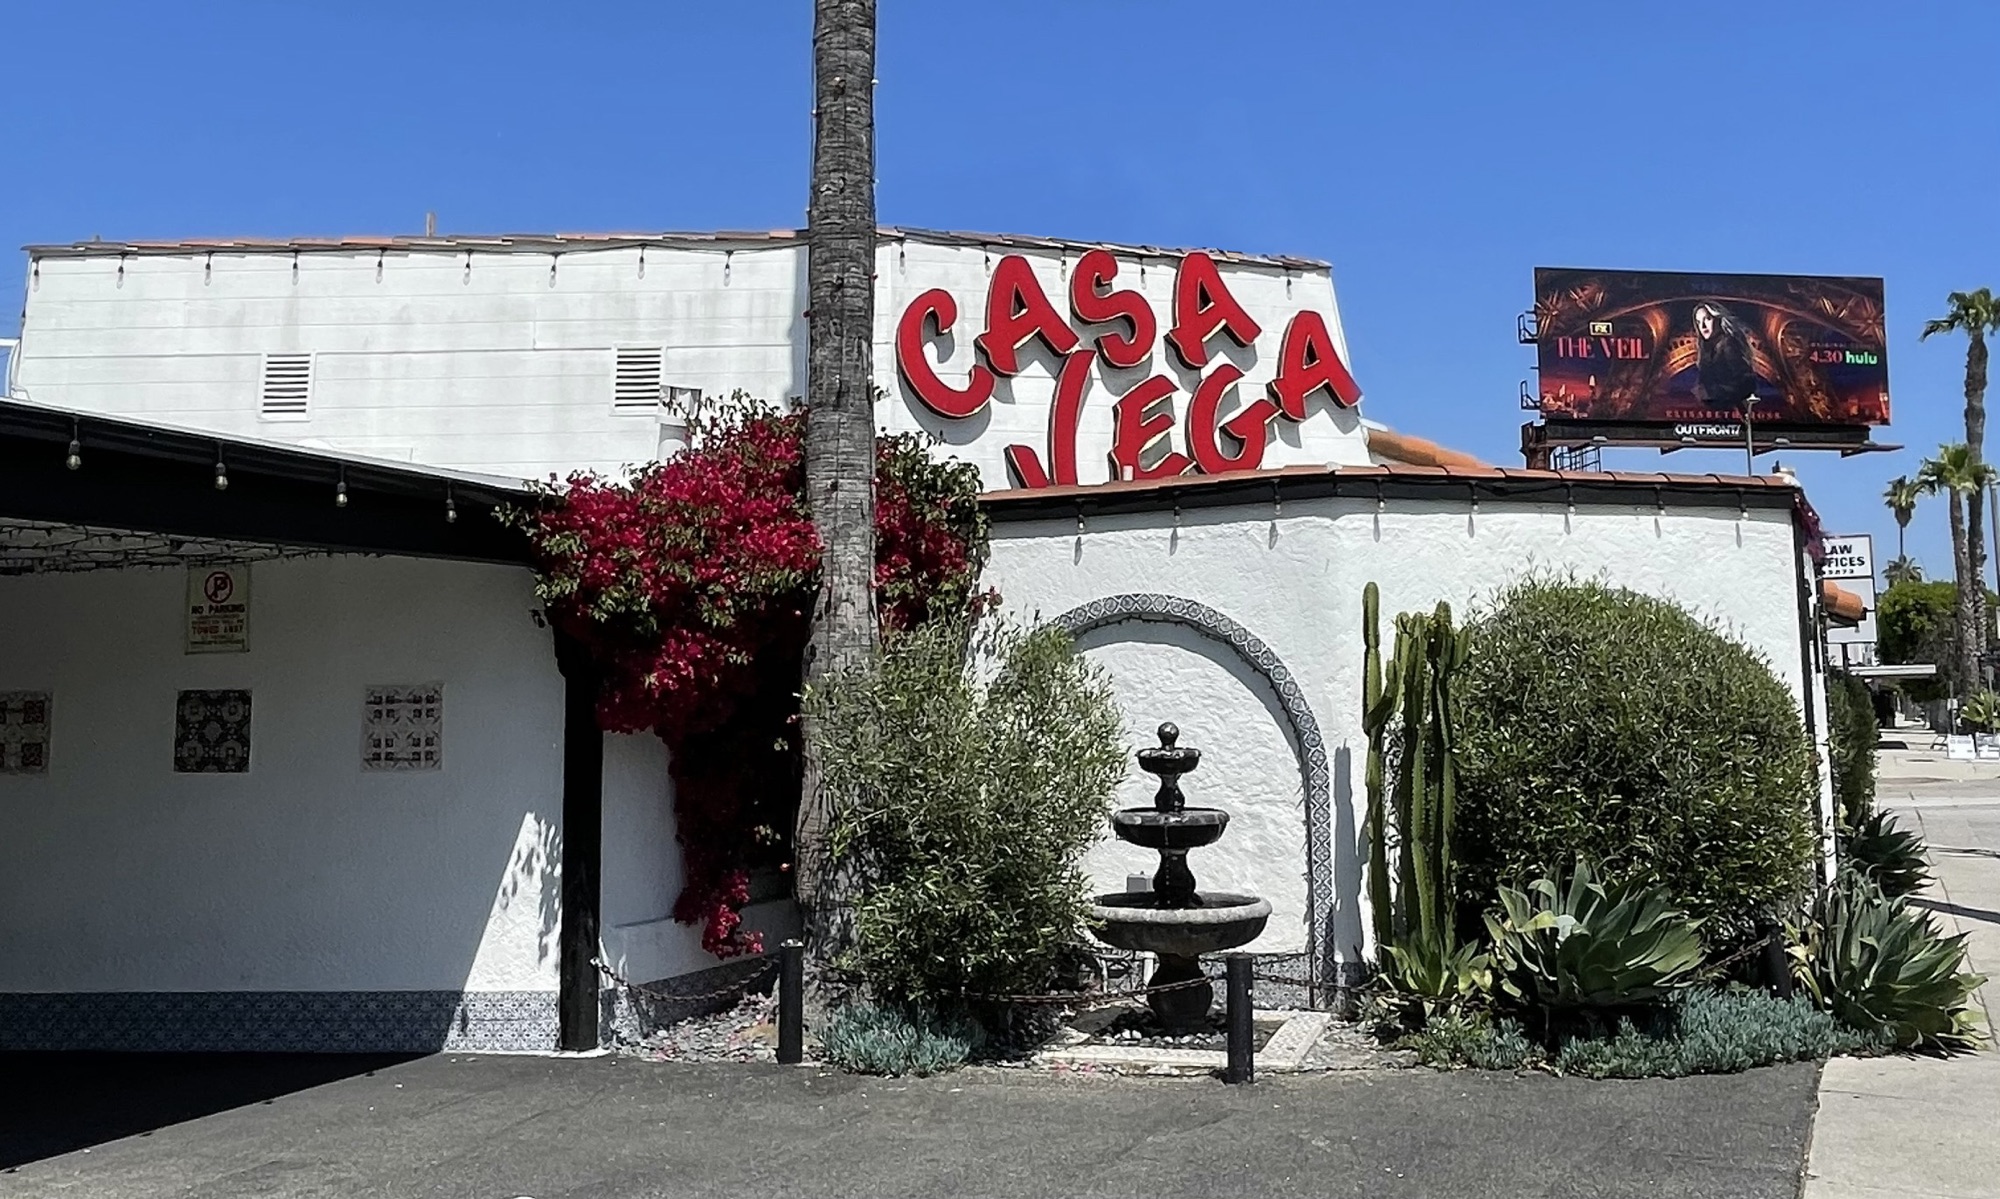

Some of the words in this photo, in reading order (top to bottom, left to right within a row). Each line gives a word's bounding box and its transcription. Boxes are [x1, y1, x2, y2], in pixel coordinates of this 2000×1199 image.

[896, 248, 1262, 419] CASA
[1556, 336, 1595, 358] THE
[1600, 336, 1650, 359] VEIL
[1845, 350, 1878, 365] hulu
[1004, 309, 1364, 489] VEGA
[191, 606, 204, 614] NO
[208, 604, 245, 613] PARKING
